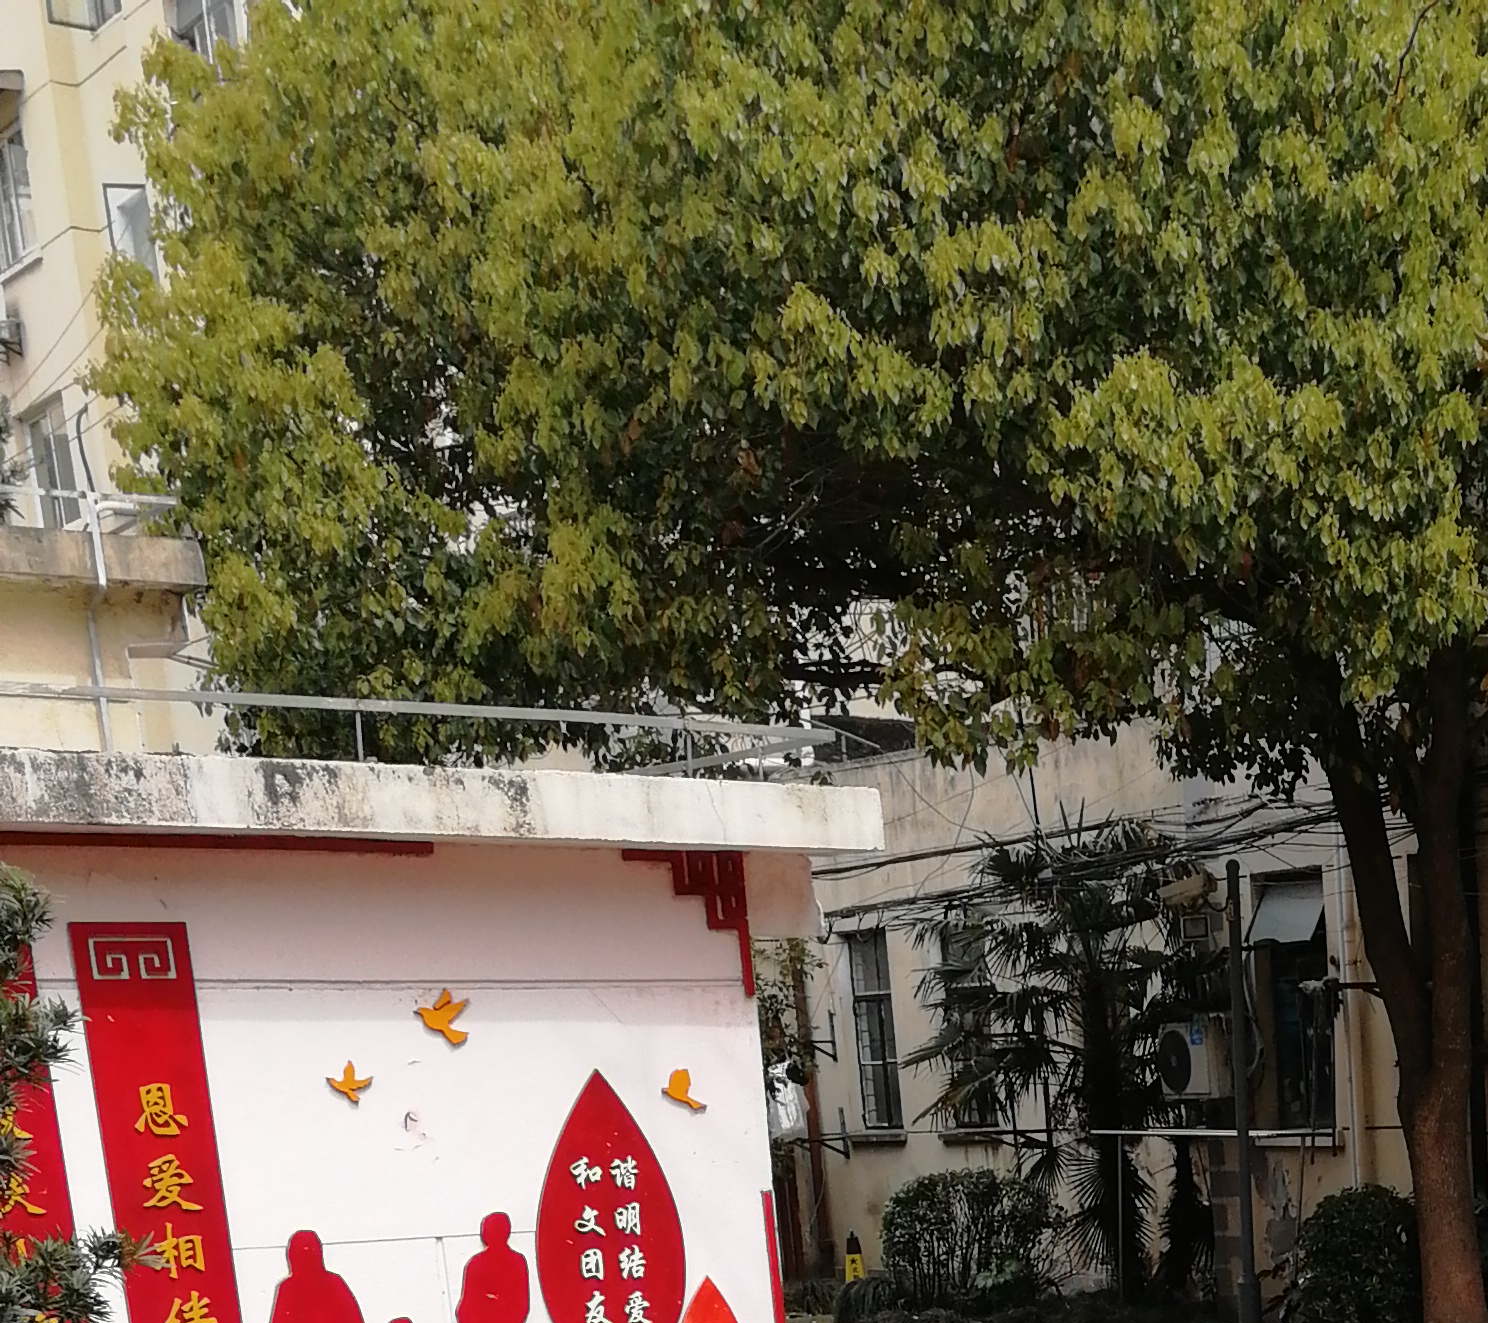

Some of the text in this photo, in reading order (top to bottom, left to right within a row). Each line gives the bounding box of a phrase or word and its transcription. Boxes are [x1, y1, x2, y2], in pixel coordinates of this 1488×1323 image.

[569, 1155, 640, 1191] 和谐
[573, 1201, 642, 1236] 文明
[579, 1244, 647, 1281] 团结
